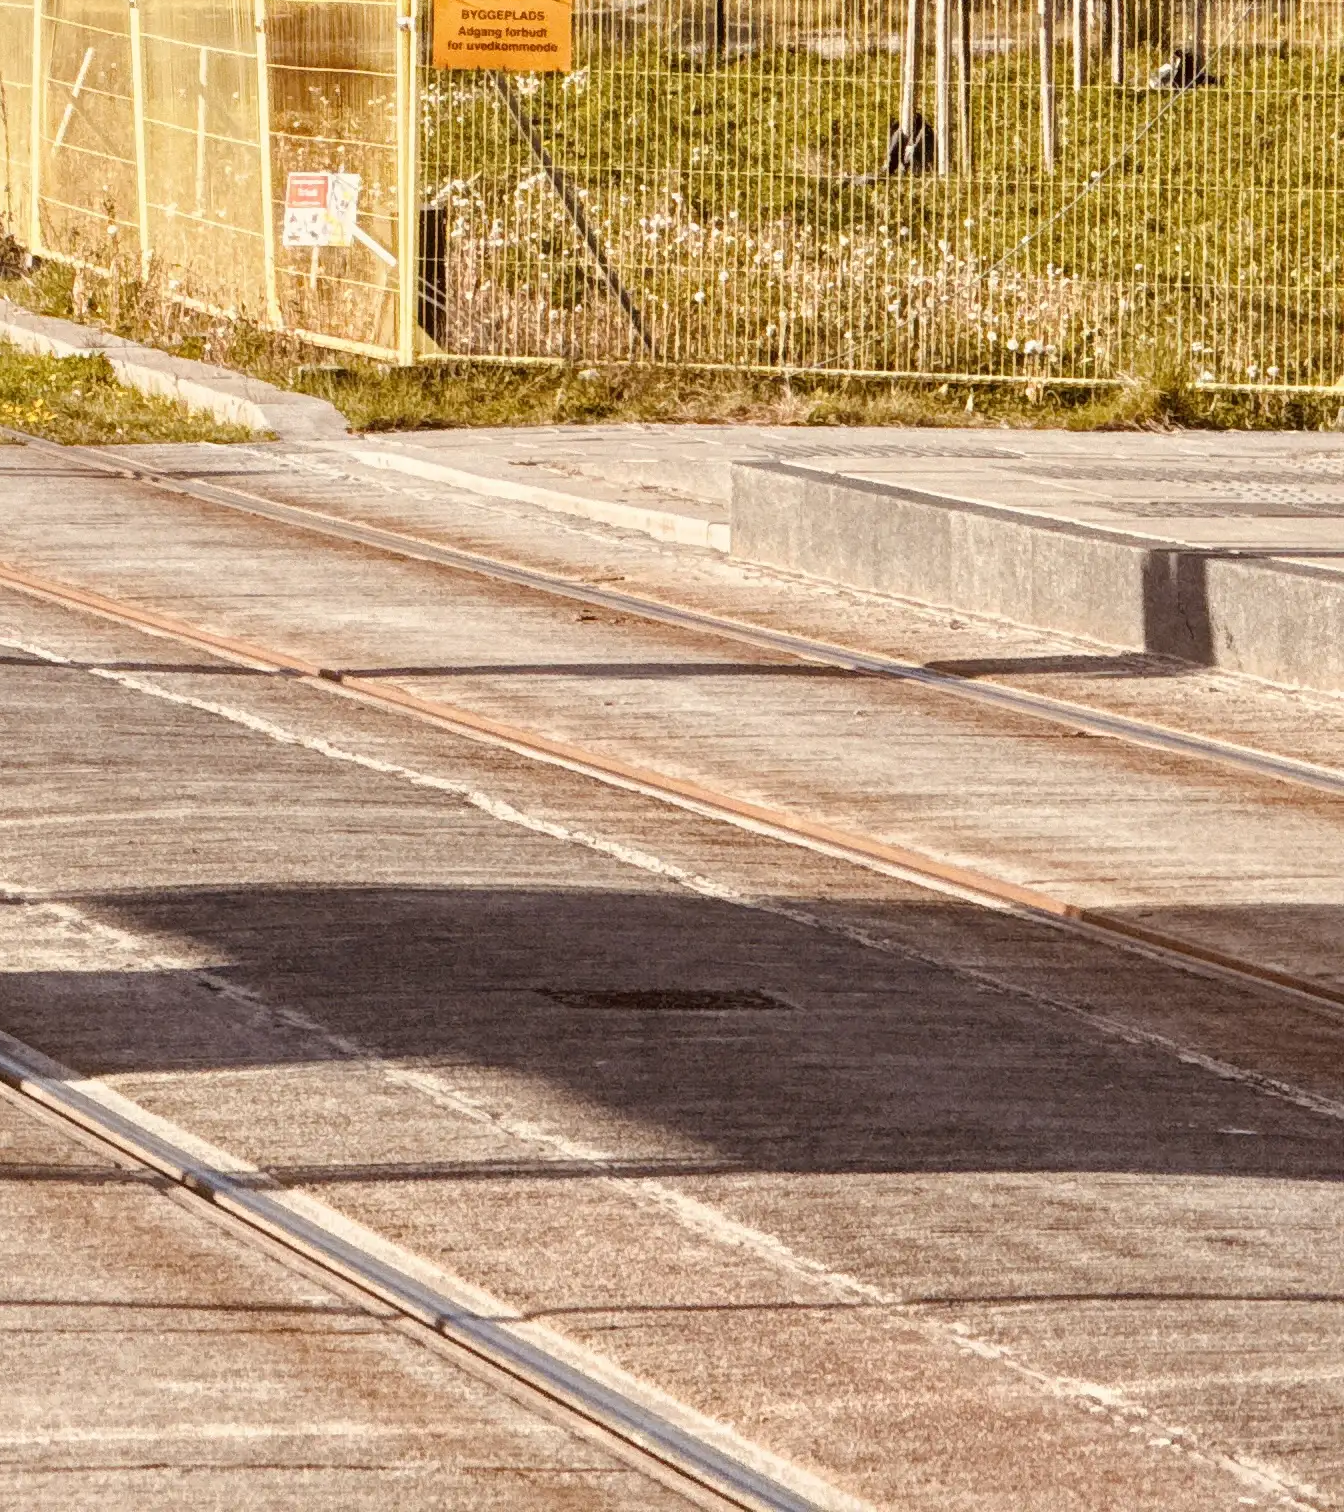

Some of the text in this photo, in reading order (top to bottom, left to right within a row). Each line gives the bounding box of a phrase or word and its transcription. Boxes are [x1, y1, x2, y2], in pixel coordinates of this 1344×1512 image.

[461, 9, 545, 21] BYGGEPLADS
[458, 25, 548, 39] Adgang forbudt
[447, 39, 558, 53] for uvedkommende
